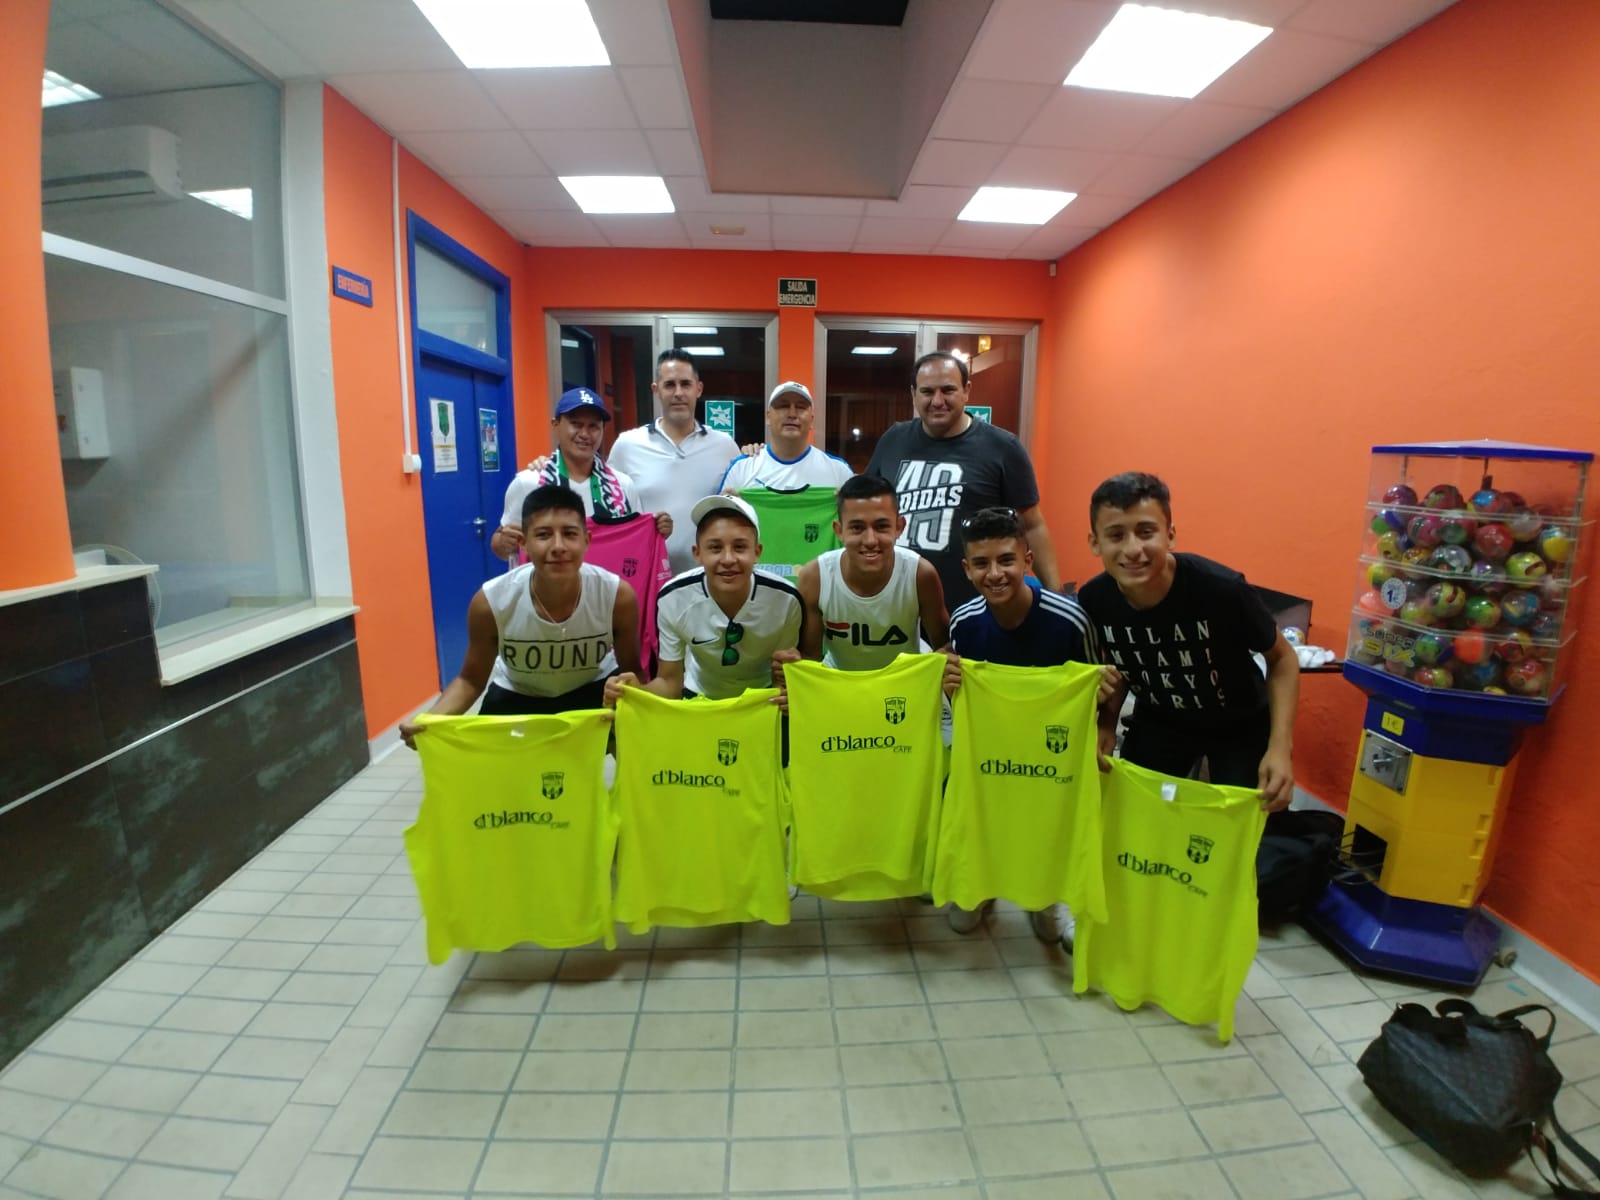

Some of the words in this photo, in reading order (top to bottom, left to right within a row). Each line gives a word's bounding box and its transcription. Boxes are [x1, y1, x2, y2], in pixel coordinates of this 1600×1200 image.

[787, 281, 808, 292] SALIDA
[779, 293, 816, 305] EMERGENCIA
[579, 390, 594, 404] LA
[898, 485, 964, 514] DIDAS
[826, 621, 909, 646] FILA
[1103, 620, 1210, 644] MILAN
[503, 640, 607, 670] ROUND
